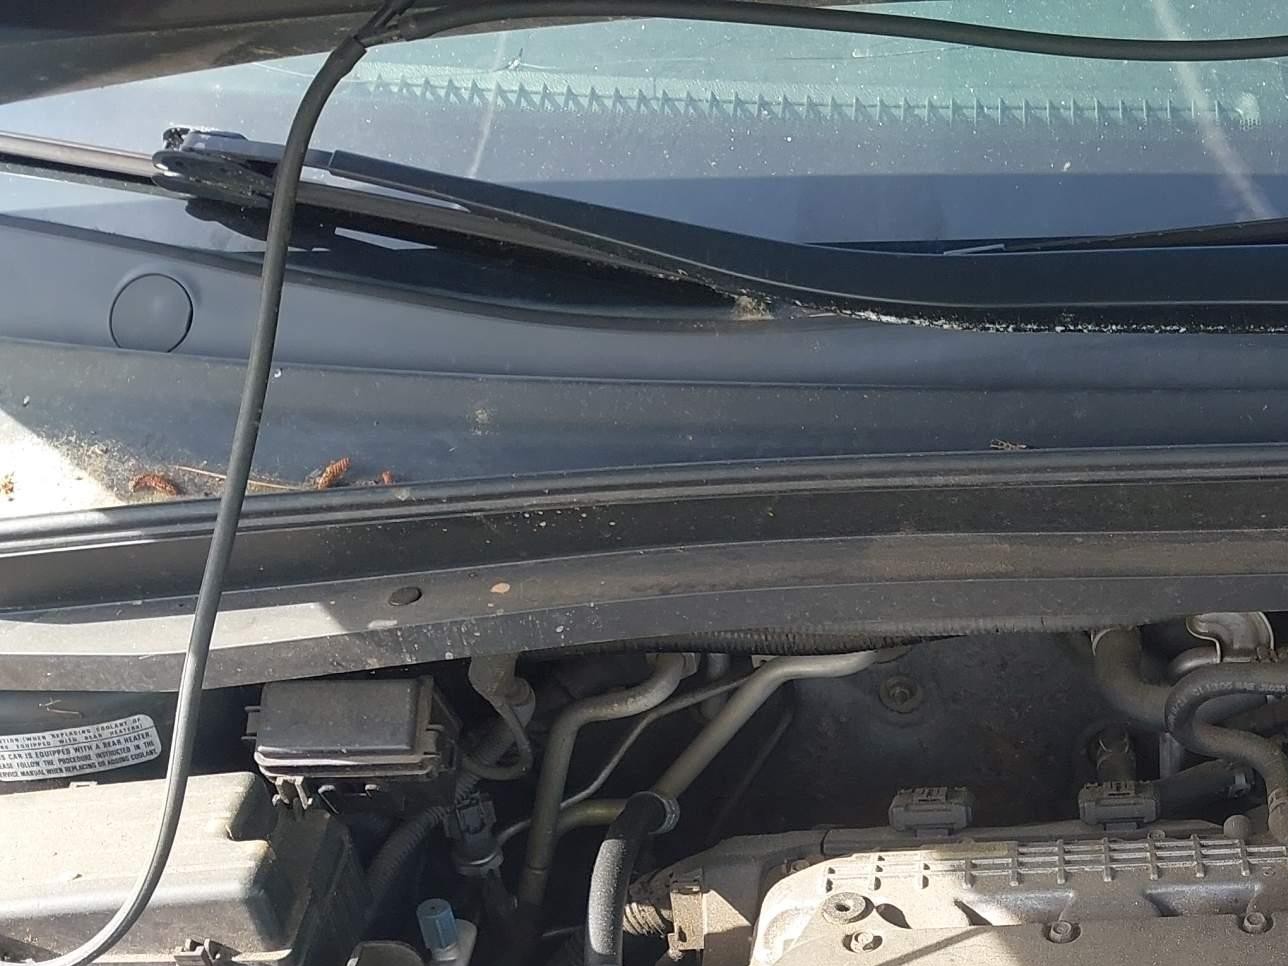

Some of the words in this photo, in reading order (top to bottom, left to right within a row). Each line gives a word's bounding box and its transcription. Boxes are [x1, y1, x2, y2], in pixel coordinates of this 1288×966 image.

[96, 721, 128, 732] COOLANT
[35, 748, 71, 758] EQUIPPED
[73, 745, 92, 753] WITH
[102, 739, 122, 749] REAR
[16, 760, 40, 768] FOLLOW
